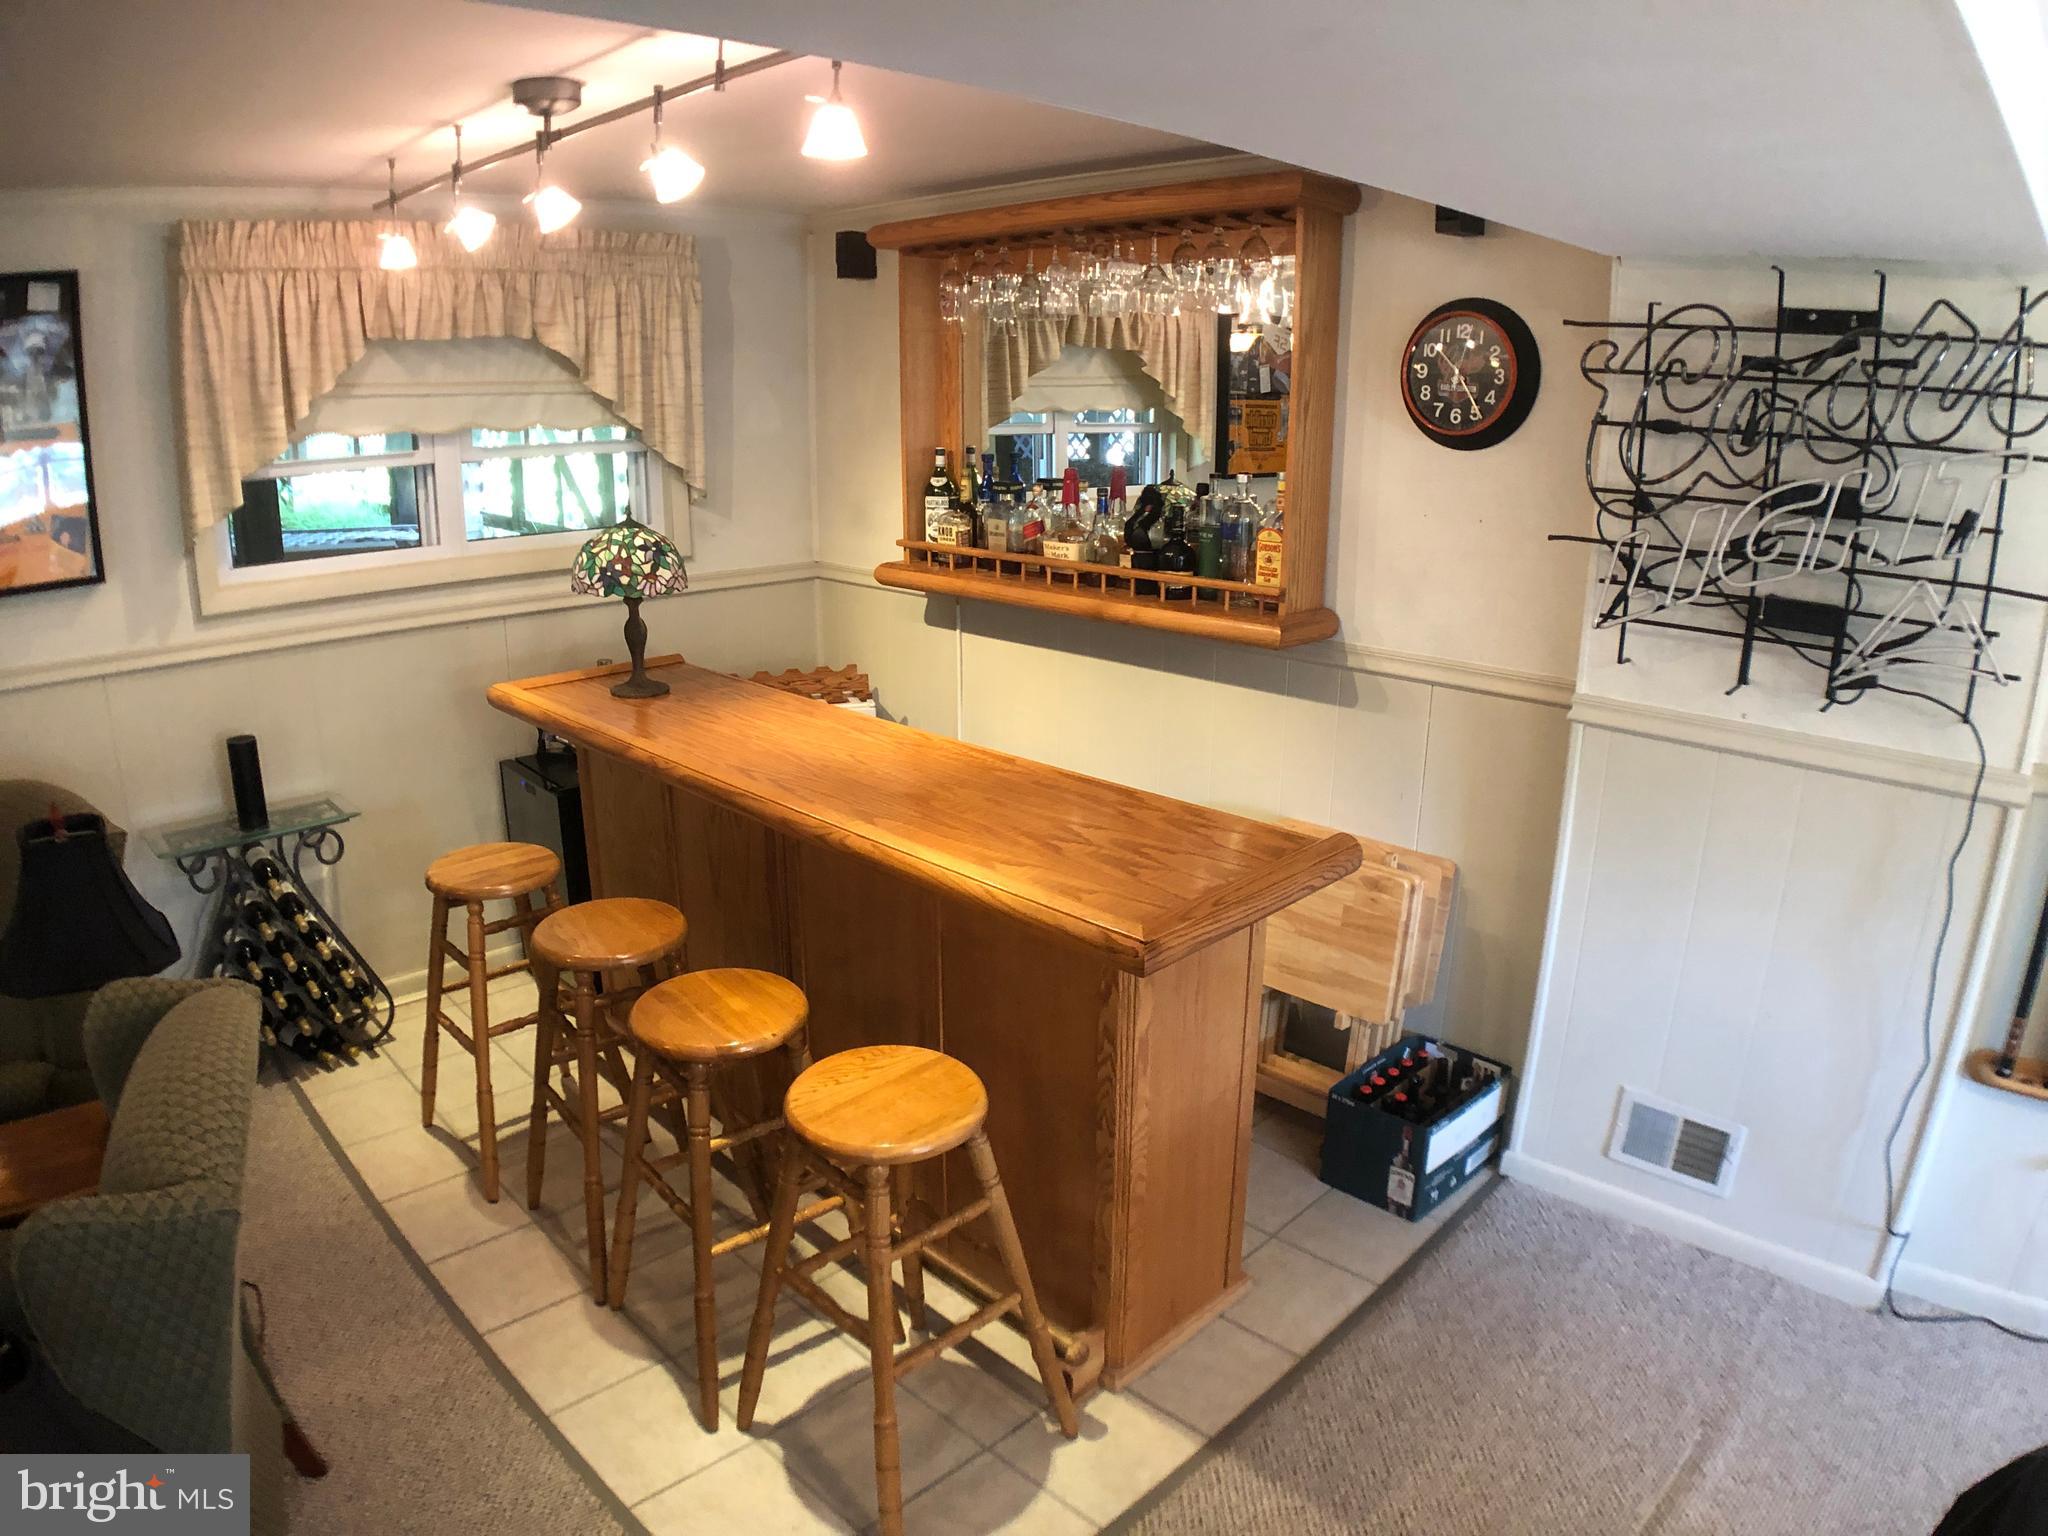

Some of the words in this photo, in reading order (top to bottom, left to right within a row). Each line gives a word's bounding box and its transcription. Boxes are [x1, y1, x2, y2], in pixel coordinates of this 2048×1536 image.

[1441, 328, 1450, 343] 11
[1456, 323, 1473, 339] 12
[1480, 330, 1484, 344] 1
[1423, 343, 1438, 358] 10
[1416, 363, 1428, 379] 9
[1494, 369, 1505, 384] 3
[1420, 385, 1431, 400] 8
[1484, 389, 1496, 405] 4
[1433, 402, 1444, 417] 7
[1450, 408, 1462, 424] 6
[1593, 448, 2034, 629] LIGHT
